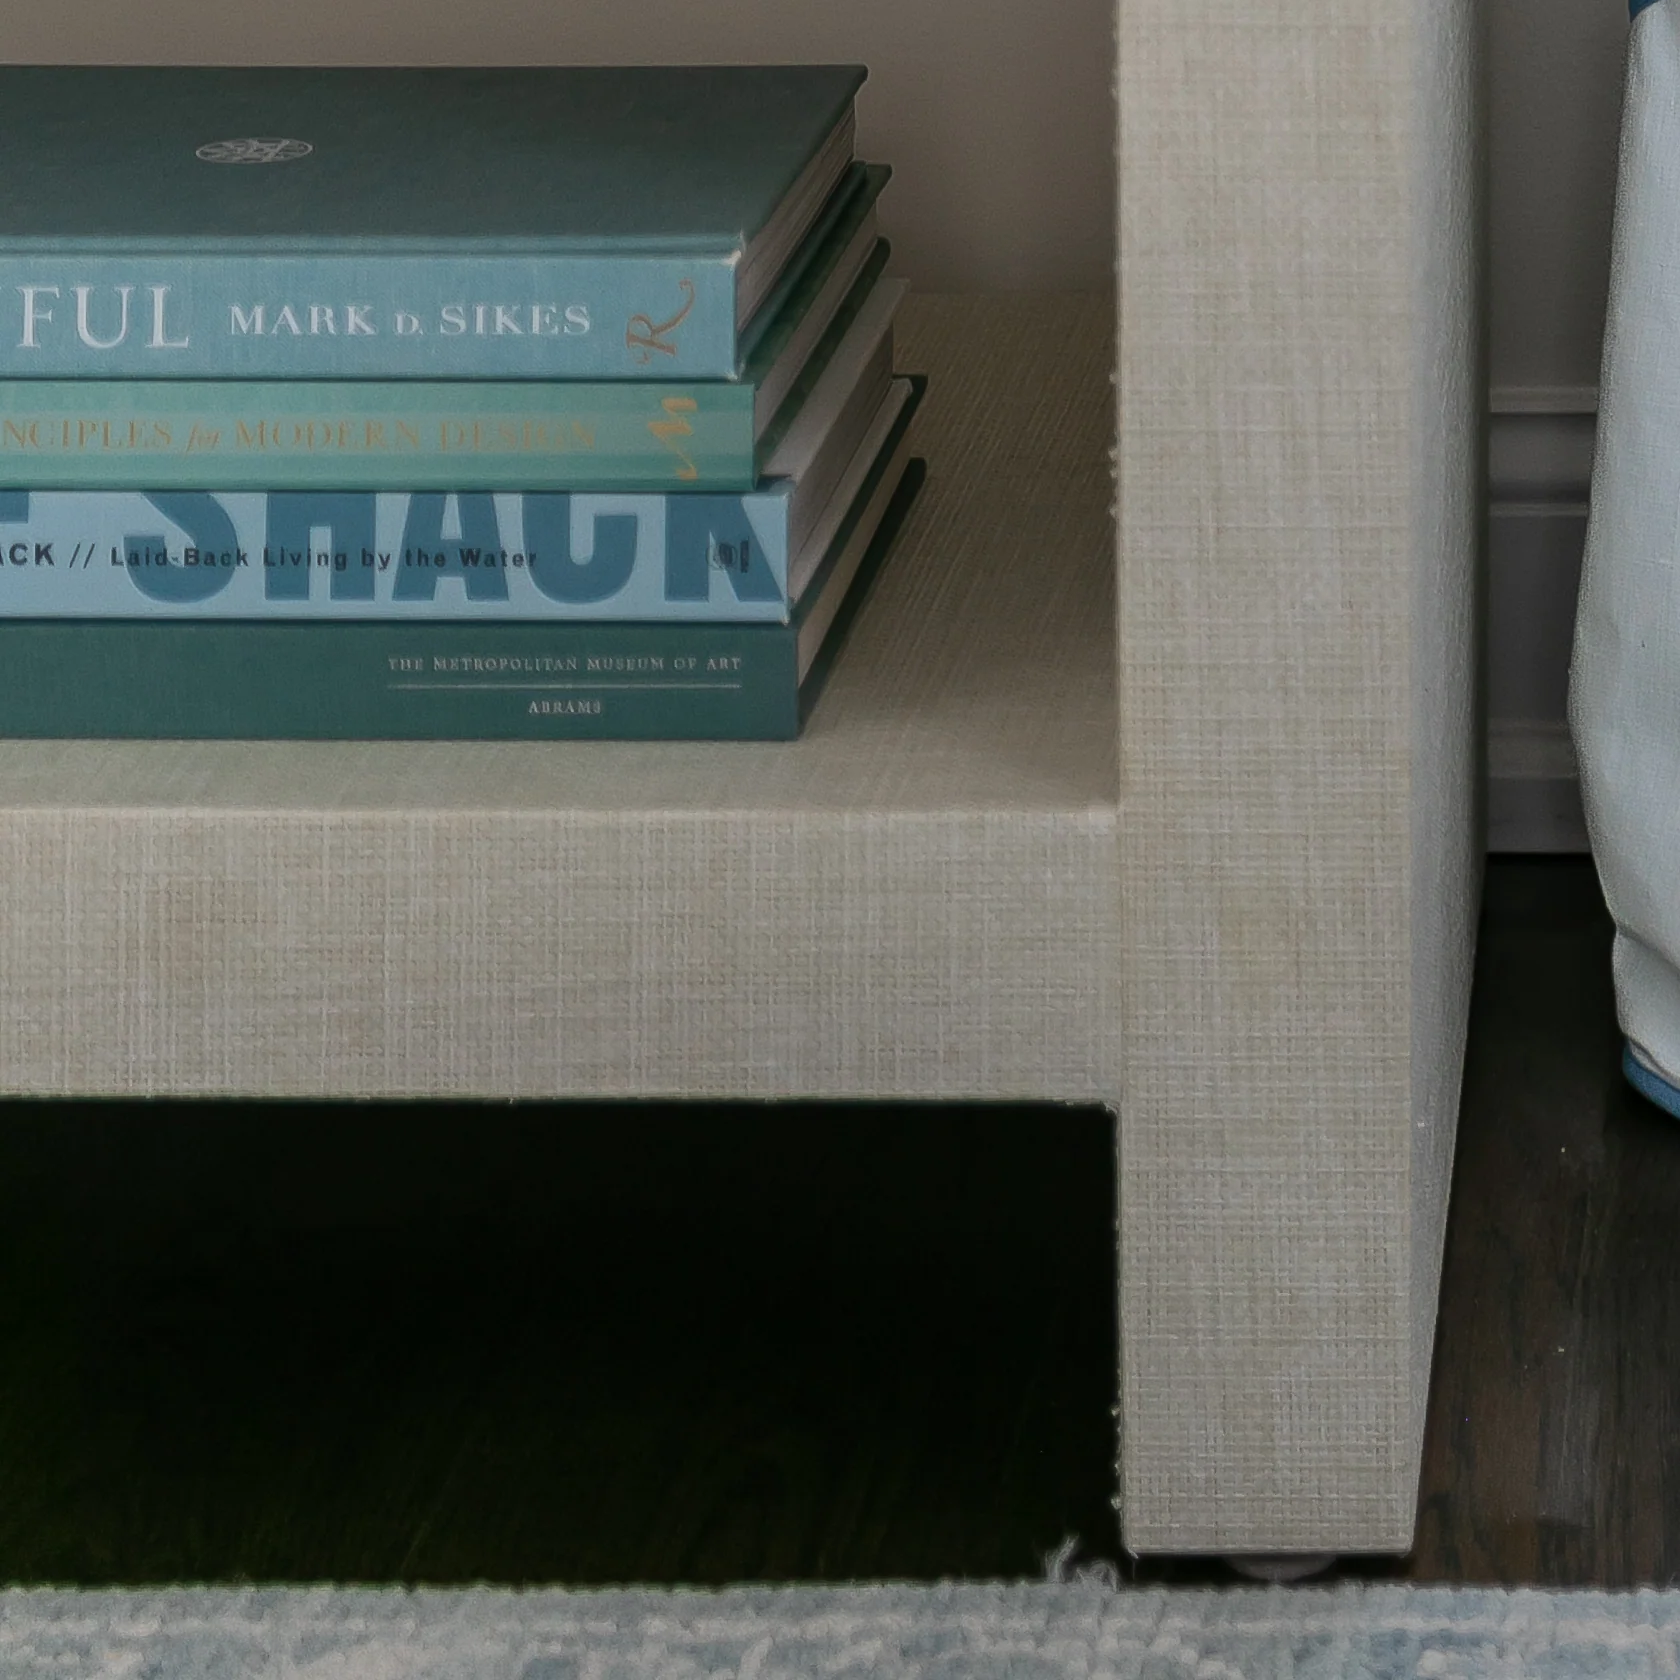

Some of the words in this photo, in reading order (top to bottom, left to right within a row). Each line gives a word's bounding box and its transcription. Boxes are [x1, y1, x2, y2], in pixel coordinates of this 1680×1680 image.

[228, 304, 377, 336] MARK
[439, 302, 591, 336] SIKES
[235, 418, 420, 450] MODERN
[440, 419, 596, 450] DESIGN
[111, 546, 249, 568] Laid-Back
[263, 547, 348, 572] Living
[361, 547, 391, 571] by
[404, 546, 447, 568] the
[458, 546, 537, 568] Water
[388, 656, 424, 672] THE
[433, 656, 577, 672] METROPOLITAN
[586, 656, 664, 672] MUSEUM
[673, 656, 698, 672] OF
[706, 656, 741, 672] ART
[528, 700, 601, 715] ABRAMS
